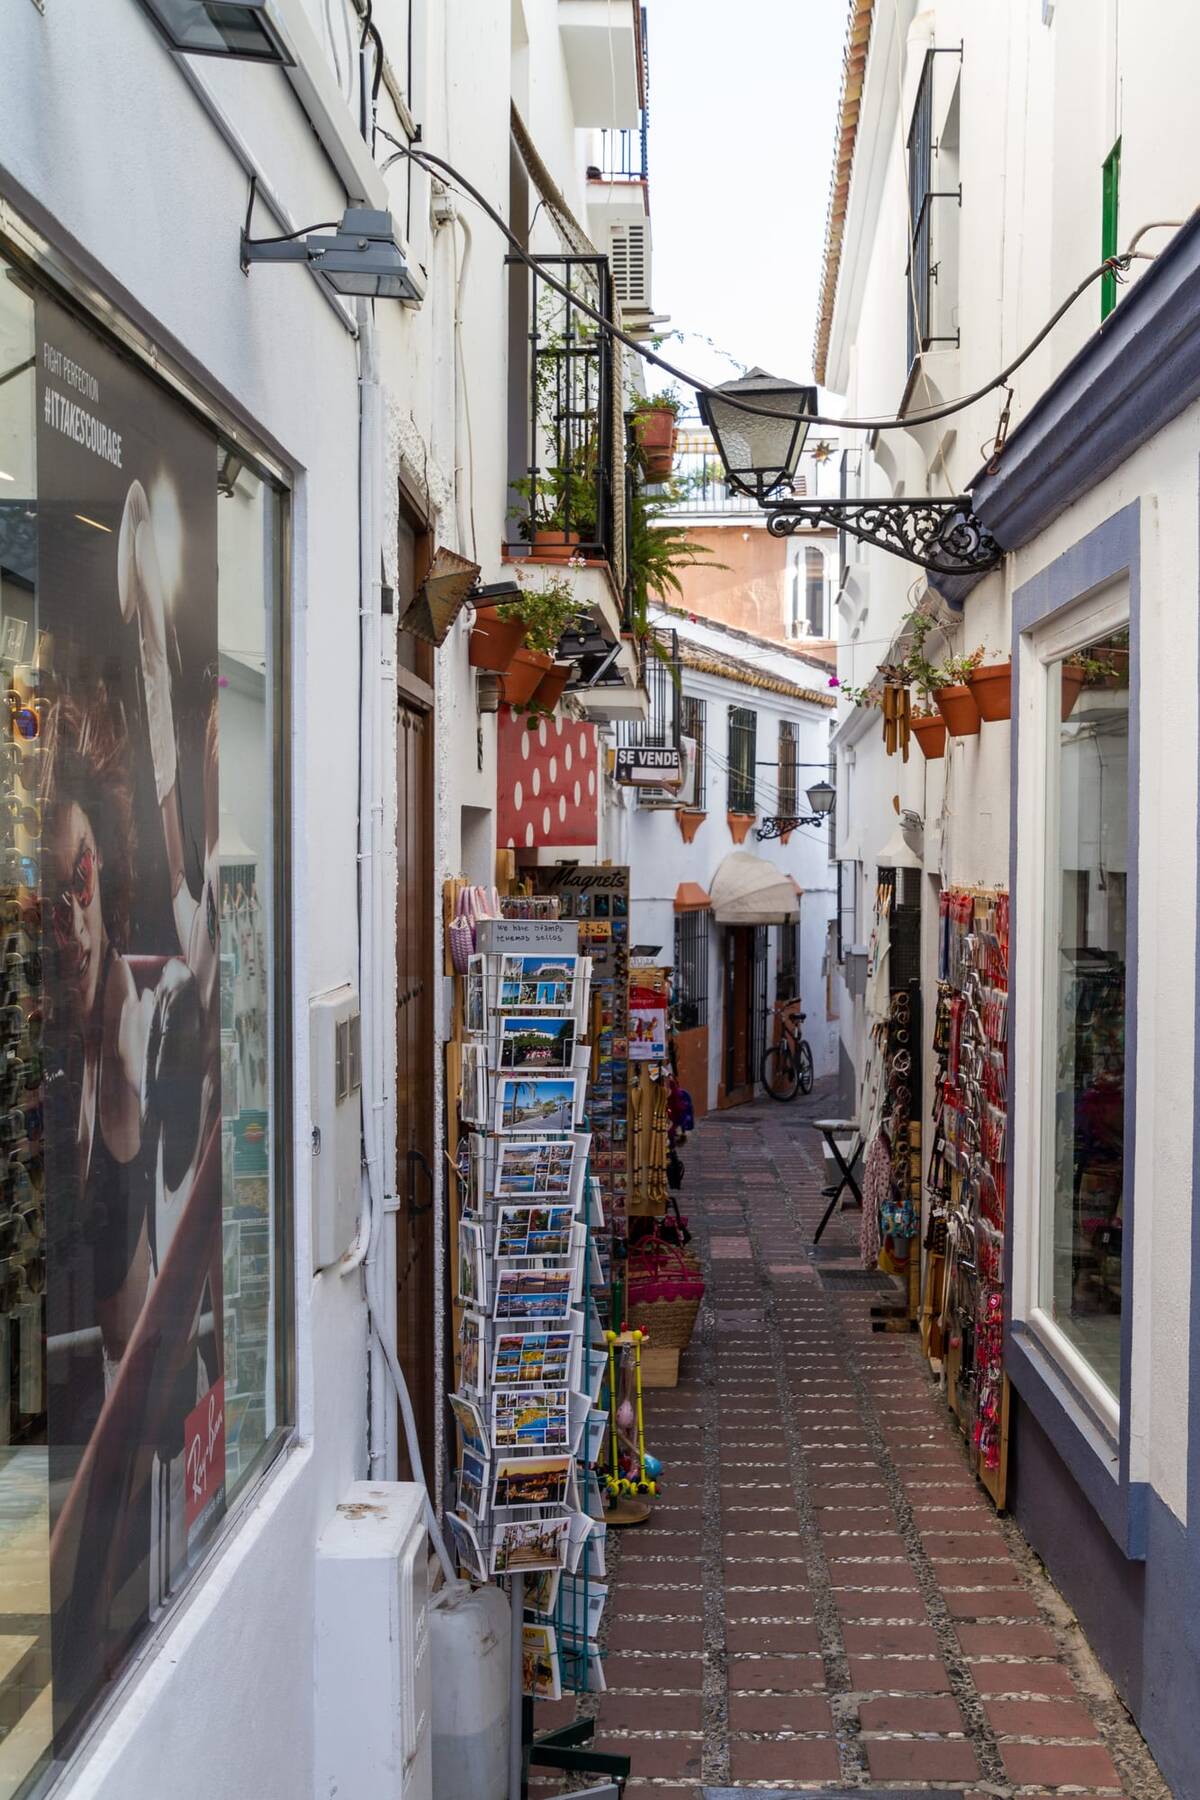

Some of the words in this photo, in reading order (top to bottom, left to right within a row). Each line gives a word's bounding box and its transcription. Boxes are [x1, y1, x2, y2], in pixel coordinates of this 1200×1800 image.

[44, 342, 62, 377] FIGHT
[63, 356, 99, 404] PERFECTION
[44, 386, 122, 468] #ITTAKESCOURAGE
[618, 750, 635, 764] SE
[639, 751, 678, 766] VENDE
[548, 867, 626, 894] Magnets
